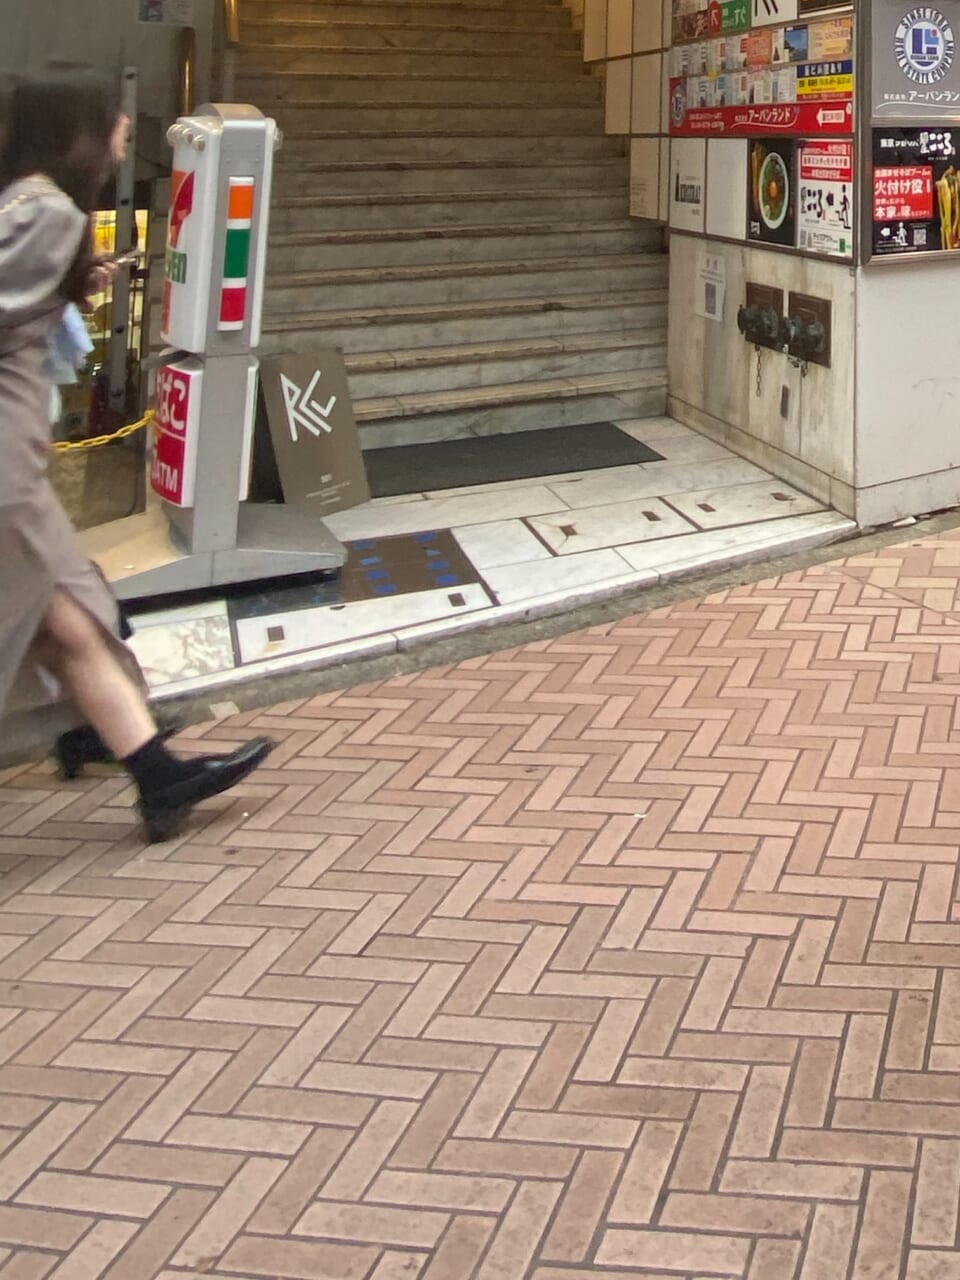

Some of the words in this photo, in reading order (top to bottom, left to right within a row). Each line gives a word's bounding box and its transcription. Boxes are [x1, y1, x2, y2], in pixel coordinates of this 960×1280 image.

[748, 107, 791, 123] アーバンランド
